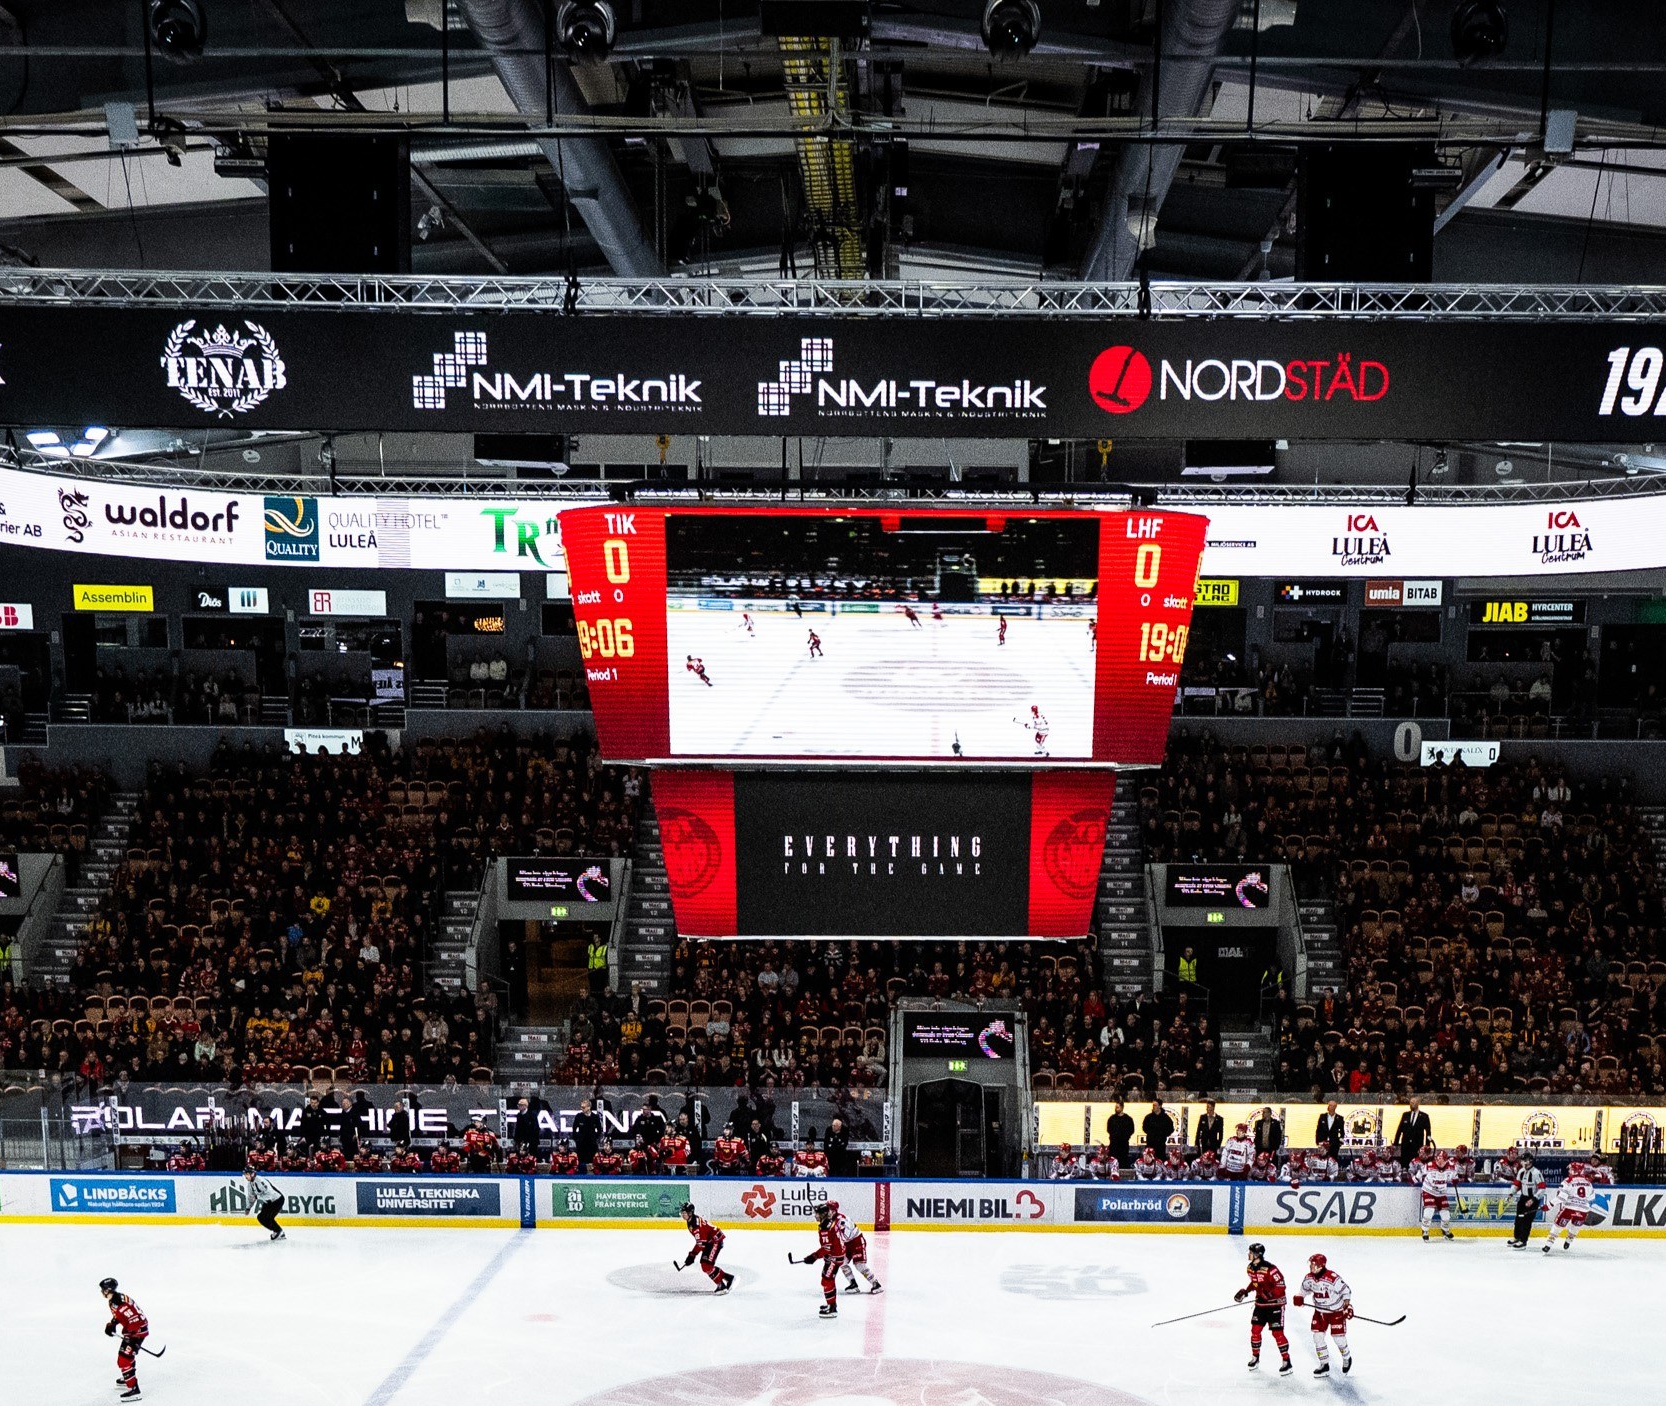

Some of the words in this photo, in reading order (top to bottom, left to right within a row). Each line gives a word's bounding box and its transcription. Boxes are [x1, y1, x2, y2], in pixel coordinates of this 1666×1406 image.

[161, 353, 287, 392] TENAB
[1160, 352, 1389, 401] NORDSTÄD
[473, 372, 703, 402] NMI-Teknik
[818, 378, 1047, 408] NMI-Teknik
[105, 496, 240, 533] waldorf
[1548, 511, 1580, 529] ICA
[24, 522, 43, 537] AB
[604, 514, 637, 535] TIK
[1126, 518, 1163, 539] LHF
[1347, 514, 1379, 532] ICA
[153, 533, 235, 545] RESTAURANT
[329, 531, 377, 549] LULEÅ
[1332, 533, 1391, 556] LULEÅ
[1532, 527, 1593, 554] LULEÅ
[266, 540, 318, 556] QUALITY
[604, 539, 631, 584] 0
[1135, 544, 1162, 588] 0
[81, 590, 147, 604] Assemblin
[577, 590, 601, 604] skott
[1306, 589, 1341, 597] HYDROCK
[1369, 587, 1401, 600] umia
[1407, 587, 1437, 600] BITAB
[1163, 594, 1188, 609] skott
[1532, 603, 1574, 612] HYRCENTER
[1483, 602, 1528, 622] JIAB
[1146, 672, 1173, 686] Period
[784, 835, 983, 858] EVERYTHING
[784, 862, 823, 875] FOR
[852, 862, 894, 875] THE
[921, 862, 983, 875] GAME
[83, 1186, 167, 1200] LINDBÄCKS
[377, 1186, 414, 1198] LULEÅ
[418, 1187, 480, 1198] TEKNISKA
[782, 1187, 827, 1201] Luleå
[1578, 1186, 1587, 1198] 9
[377, 1199, 455, 1209] UNIVERSITET
[595, 1199, 613, 1208] FRÅN
[907, 1198, 974, 1218] NIEMI
[979, 1198, 1012, 1218] BIL
[1102, 1198, 1162, 1212] Polarbröd
[1272, 1190, 1376, 1225] SSAB
